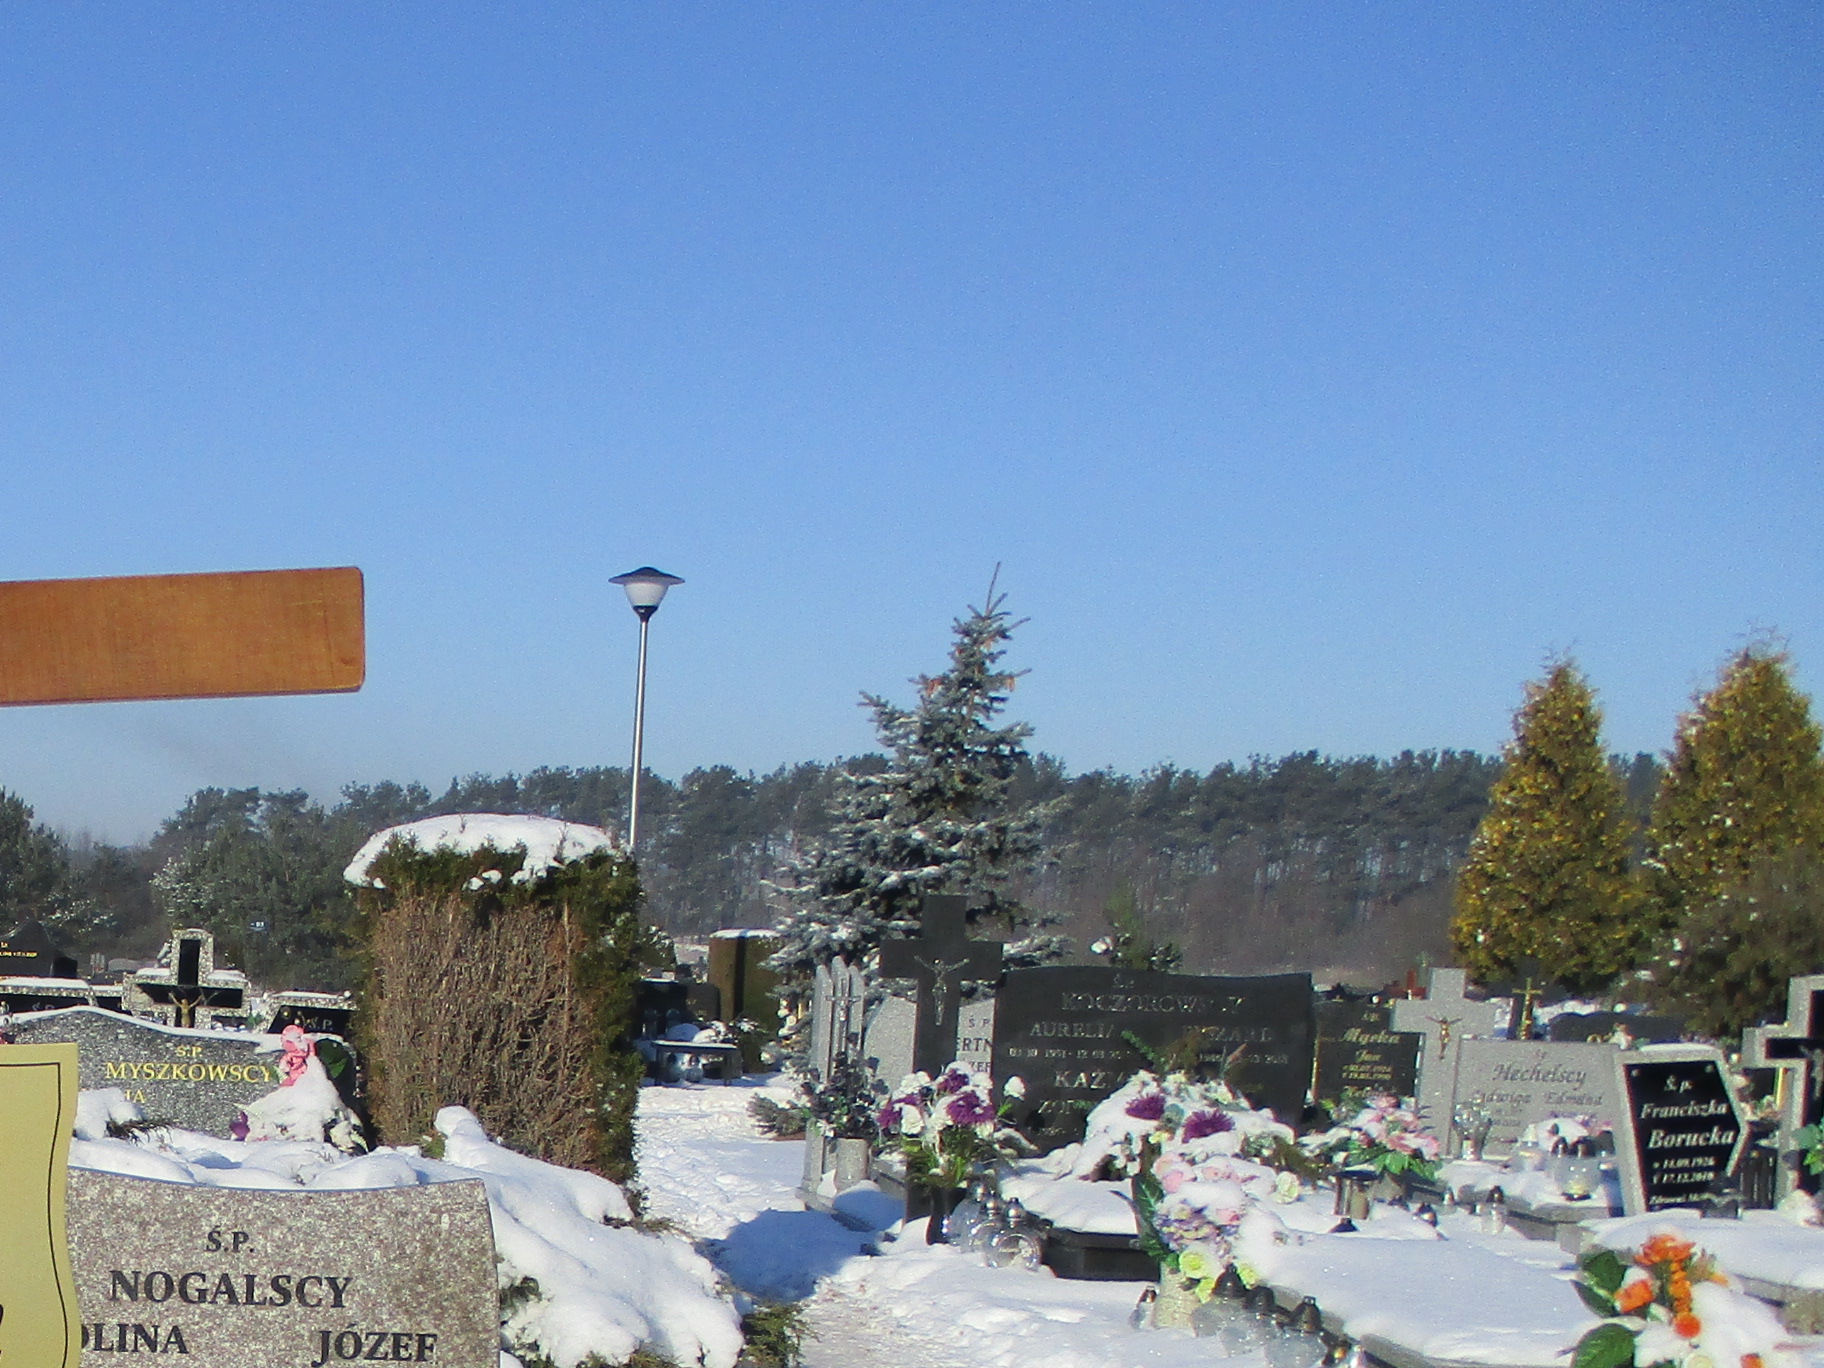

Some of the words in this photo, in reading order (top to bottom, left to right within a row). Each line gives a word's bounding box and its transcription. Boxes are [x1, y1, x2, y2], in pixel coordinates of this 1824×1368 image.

[105, 1061, 273, 1083] MYSZKOWSCY
[1648, 1126, 1736, 1149] Borucka
[205, 1225, 256, 1254] Ś.P.
[109, 1269, 355, 1309] NOGALSCY
[311, 1323, 439, 1368] JÓZEF
